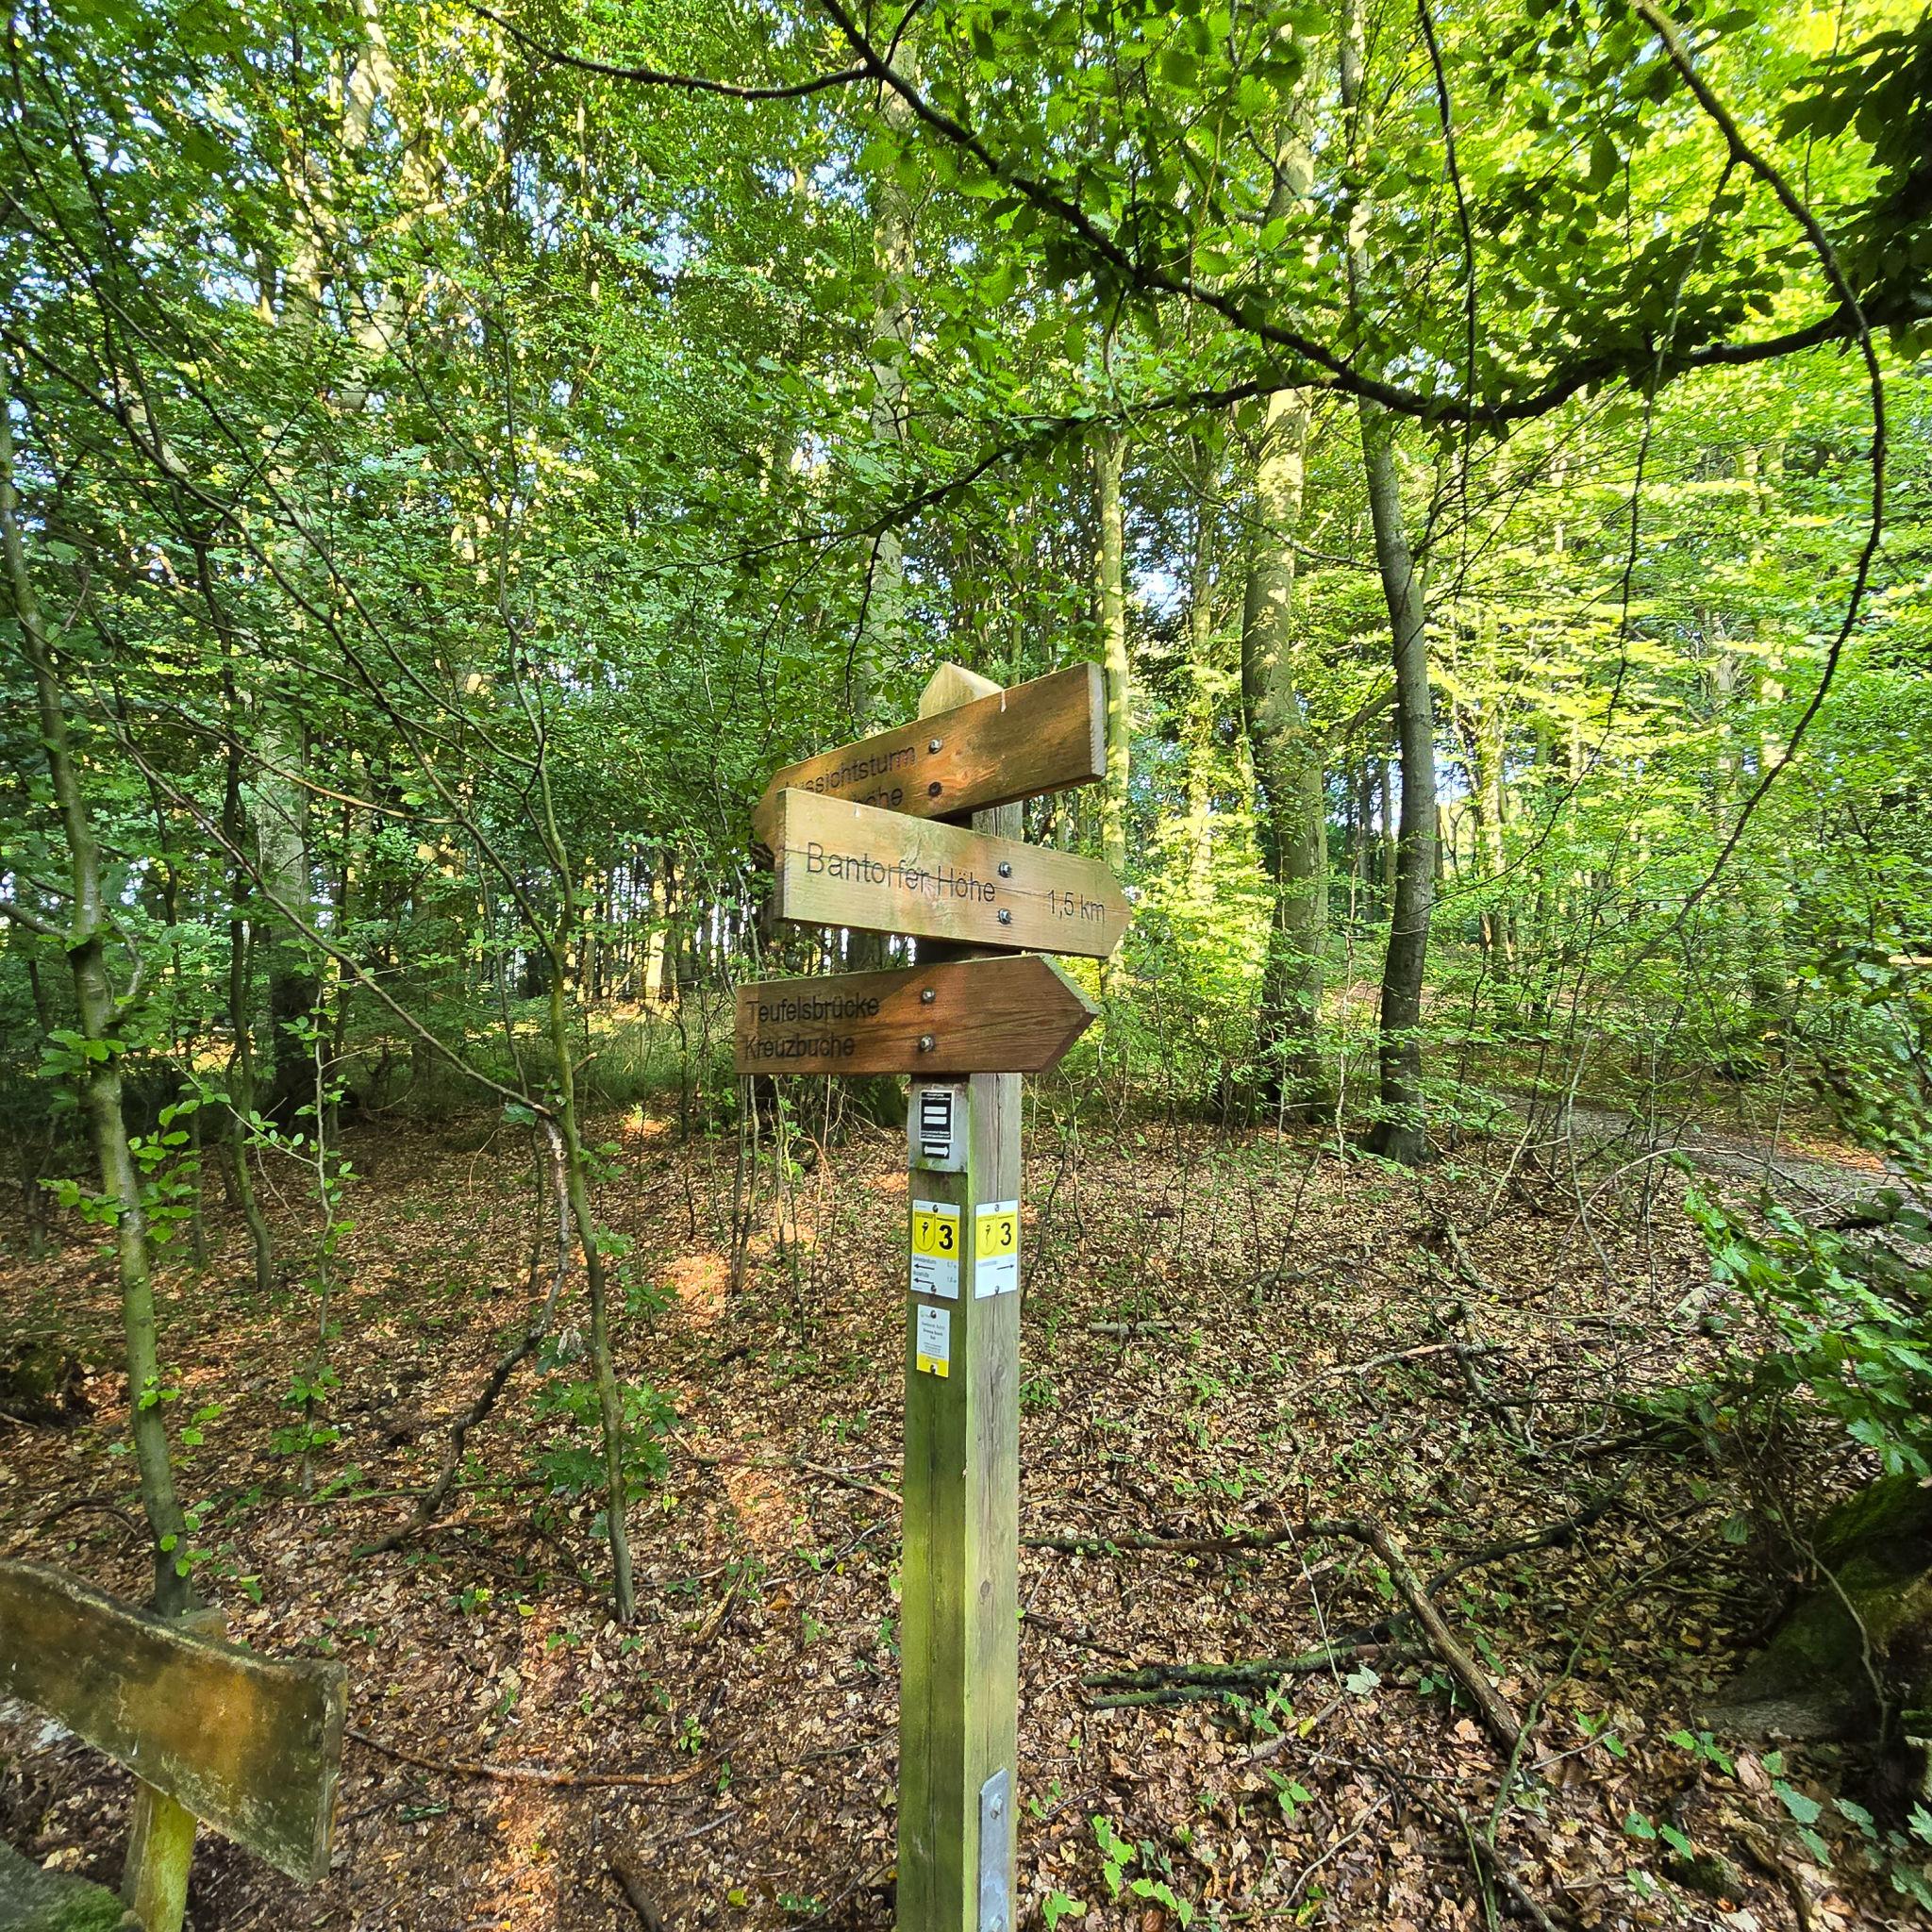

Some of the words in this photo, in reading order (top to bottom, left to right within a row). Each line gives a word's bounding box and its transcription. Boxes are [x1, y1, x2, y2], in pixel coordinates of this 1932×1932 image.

[785, 746, 916, 794] ssichtsturm
[807, 841, 930, 892] Bantorfer
[938, 865, 996, 903] Höhe
[1047, 889, 1074, 921] 1,5
[1080, 893, 1106, 925] km
[745, 992, 880, 1024] Teufelsbrücke
[744, 1032, 856, 1060] Kreuzbuche
[939, 1224, 954, 1251] 3
[1000, 1222, 1012, 1246] 3
